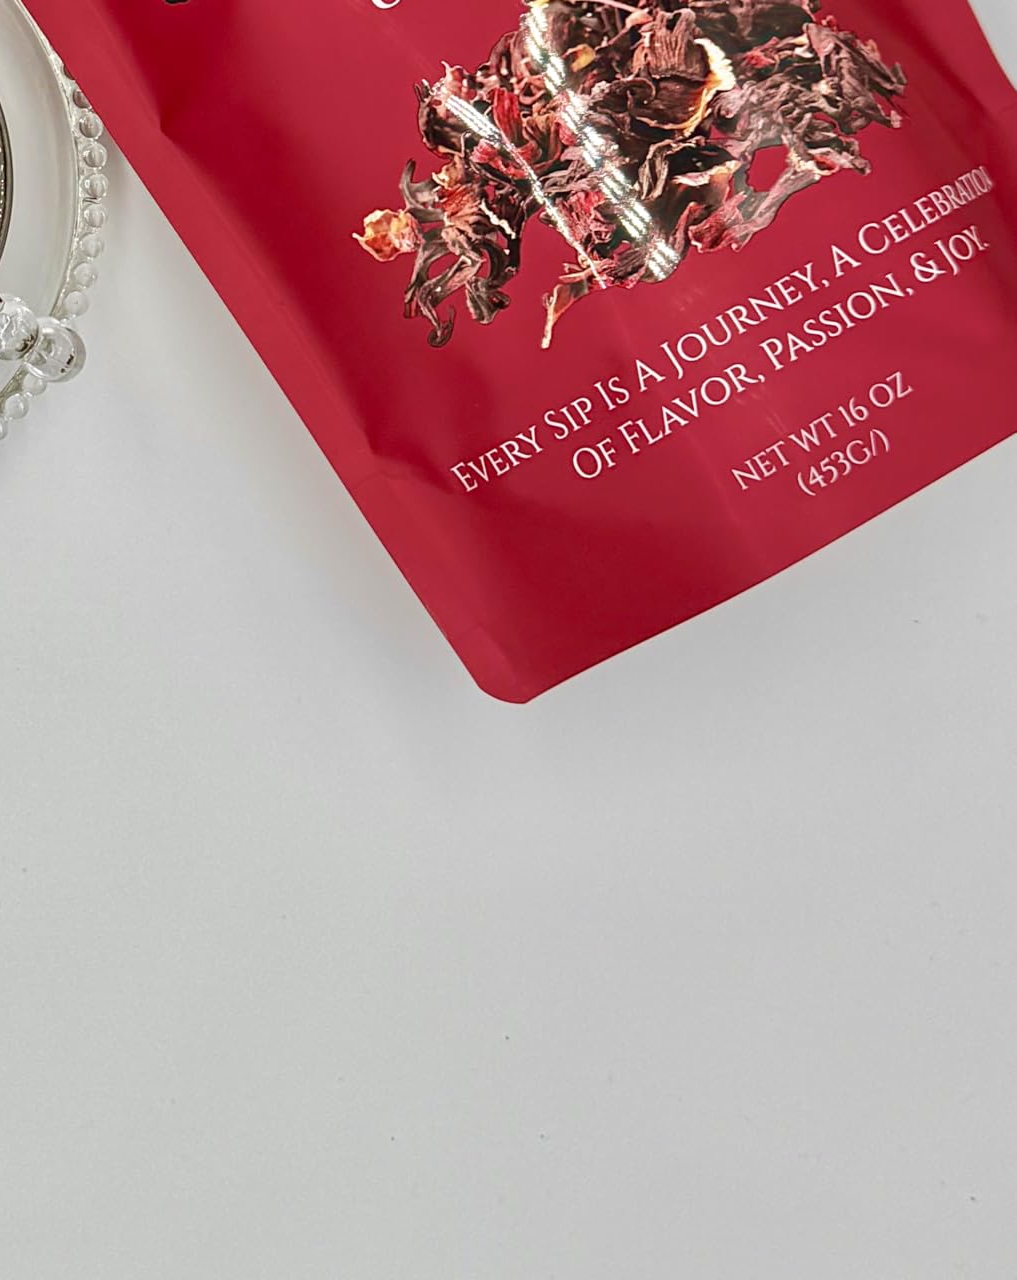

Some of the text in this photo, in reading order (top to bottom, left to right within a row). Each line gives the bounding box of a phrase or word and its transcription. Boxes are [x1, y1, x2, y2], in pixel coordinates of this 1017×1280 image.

[450, 425, 543, 492] EVERY
[544, 397, 592, 440] SIP
[594, 376, 630, 411] IS
[635, 359, 665, 392] A
[660, 262, 830, 379] JOURNEY,
[830, 244, 861, 277] A
[572, 438, 617, 479] OF
[618, 363, 766, 454] FLAVOR,
[759, 273, 914, 370] PASSION,
[909, 252, 947, 282] &
[732, 371, 913, 490] NET WT 16 OZ
